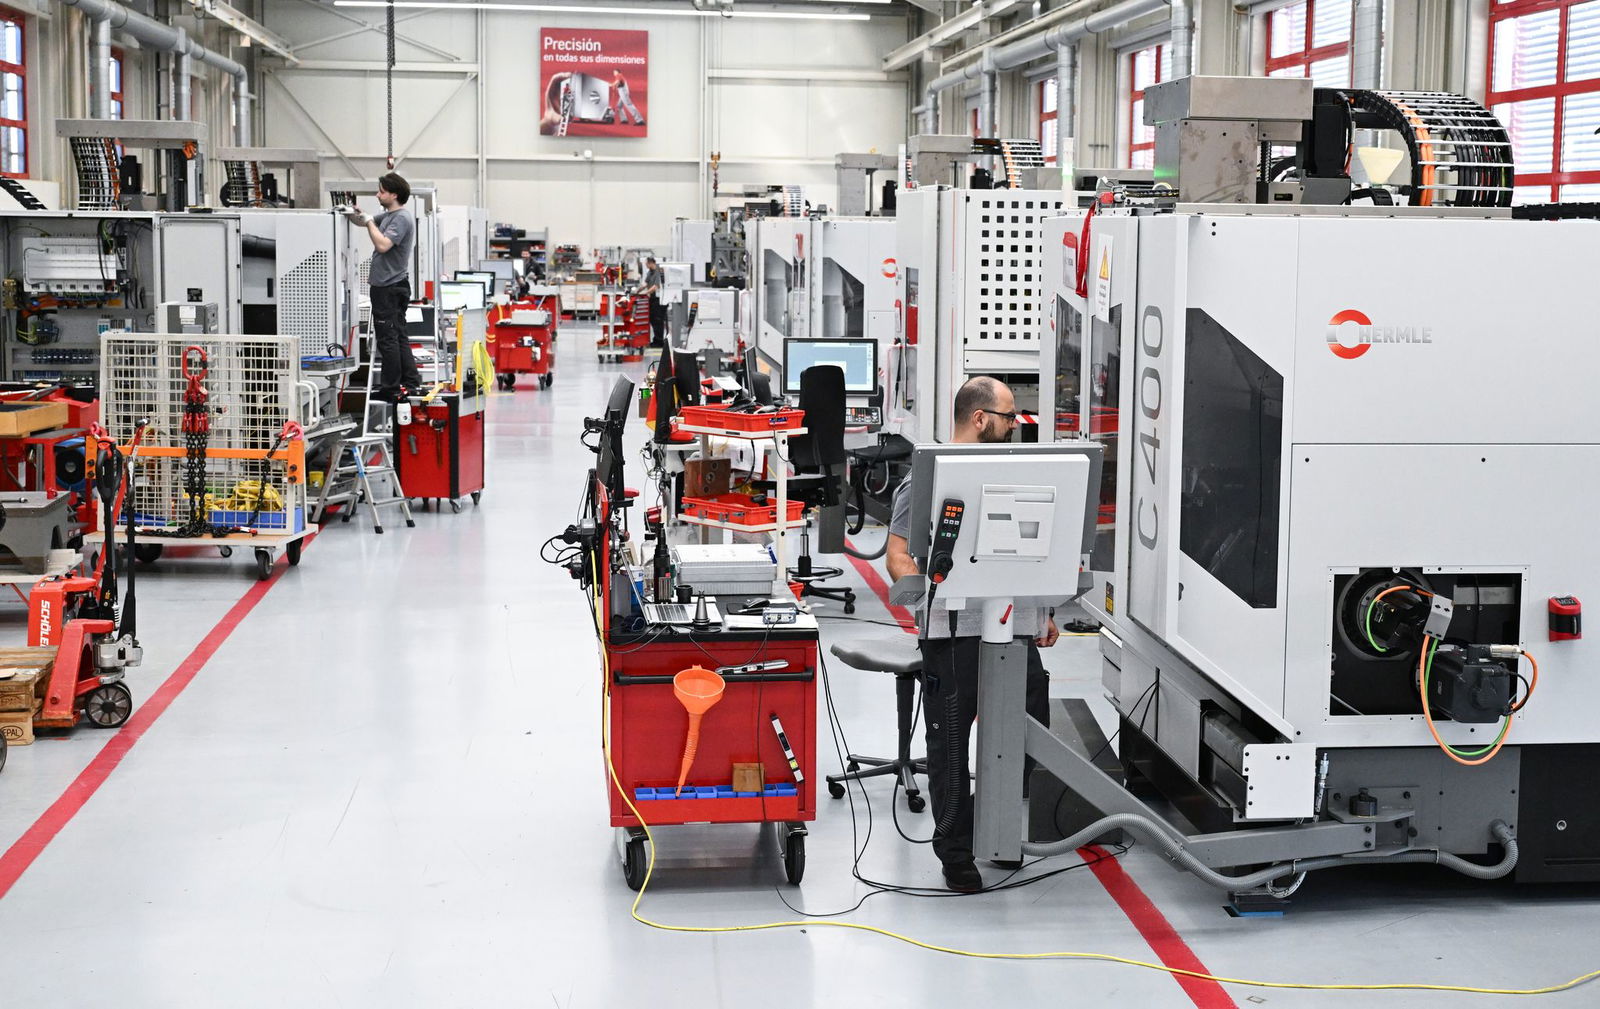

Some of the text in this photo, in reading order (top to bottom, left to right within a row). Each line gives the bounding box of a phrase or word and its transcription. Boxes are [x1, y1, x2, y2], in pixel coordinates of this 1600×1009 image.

[544, 36, 601, 51] Precisión
[556, 53, 578, 62] todas
[580, 55, 594, 63] sus
[595, 55, 645, 65] dimensiones
[1359, 326, 1432, 344] HERMLE
[1138, 305, 1163, 550] C 400
